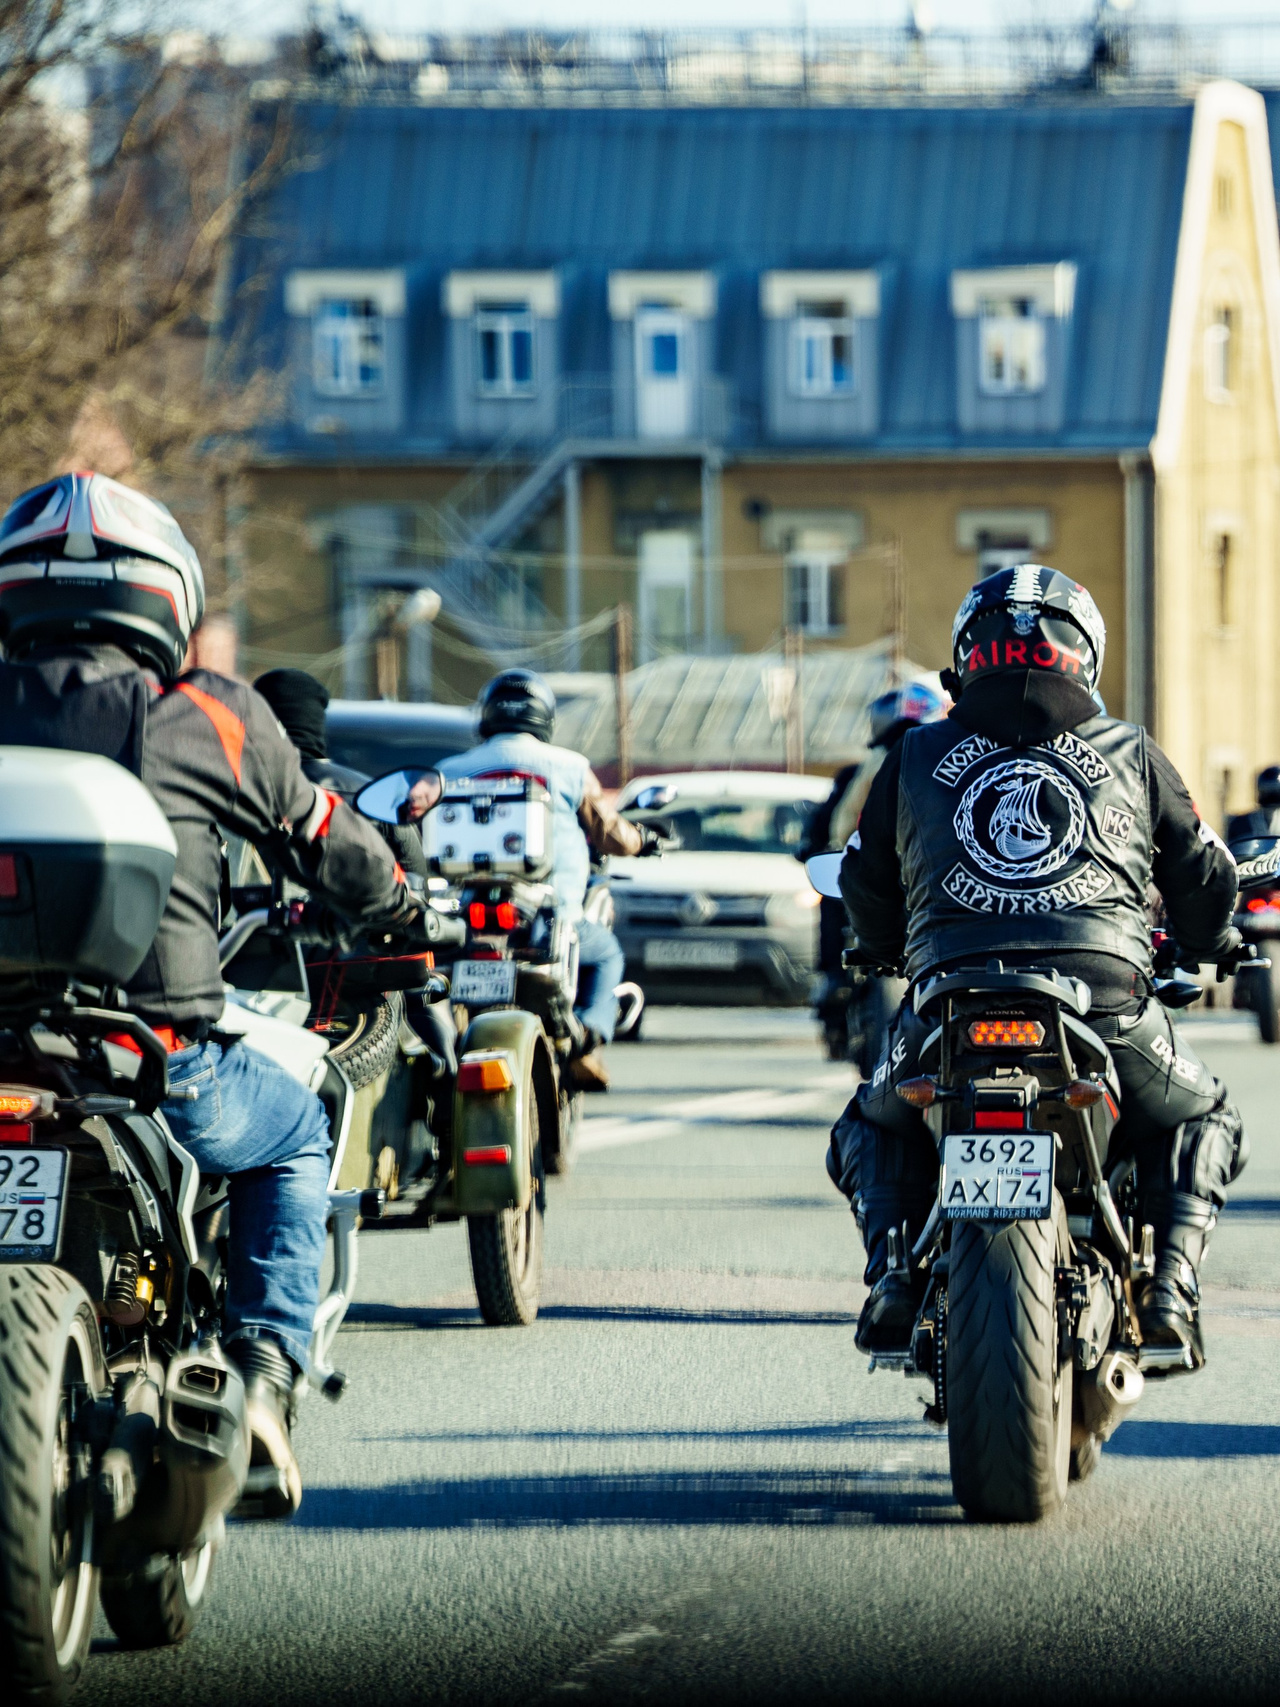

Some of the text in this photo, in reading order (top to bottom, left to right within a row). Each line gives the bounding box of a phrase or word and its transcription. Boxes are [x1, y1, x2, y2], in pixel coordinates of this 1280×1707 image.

[969, 639, 1081, 675] AIROH
[939, 735, 998, 780] NORM
[1103, 810, 1131, 838] MC
[961, 1139, 1035, 1163] 3692
[997, 1167, 1022, 1176] RUS
[948, 1179, 1041, 1204] AX 74
[0, 1208, 45, 1240] 78
[947, 1208, 990, 1219] NORMANS
[1029, 1208, 1042, 1219] MC
